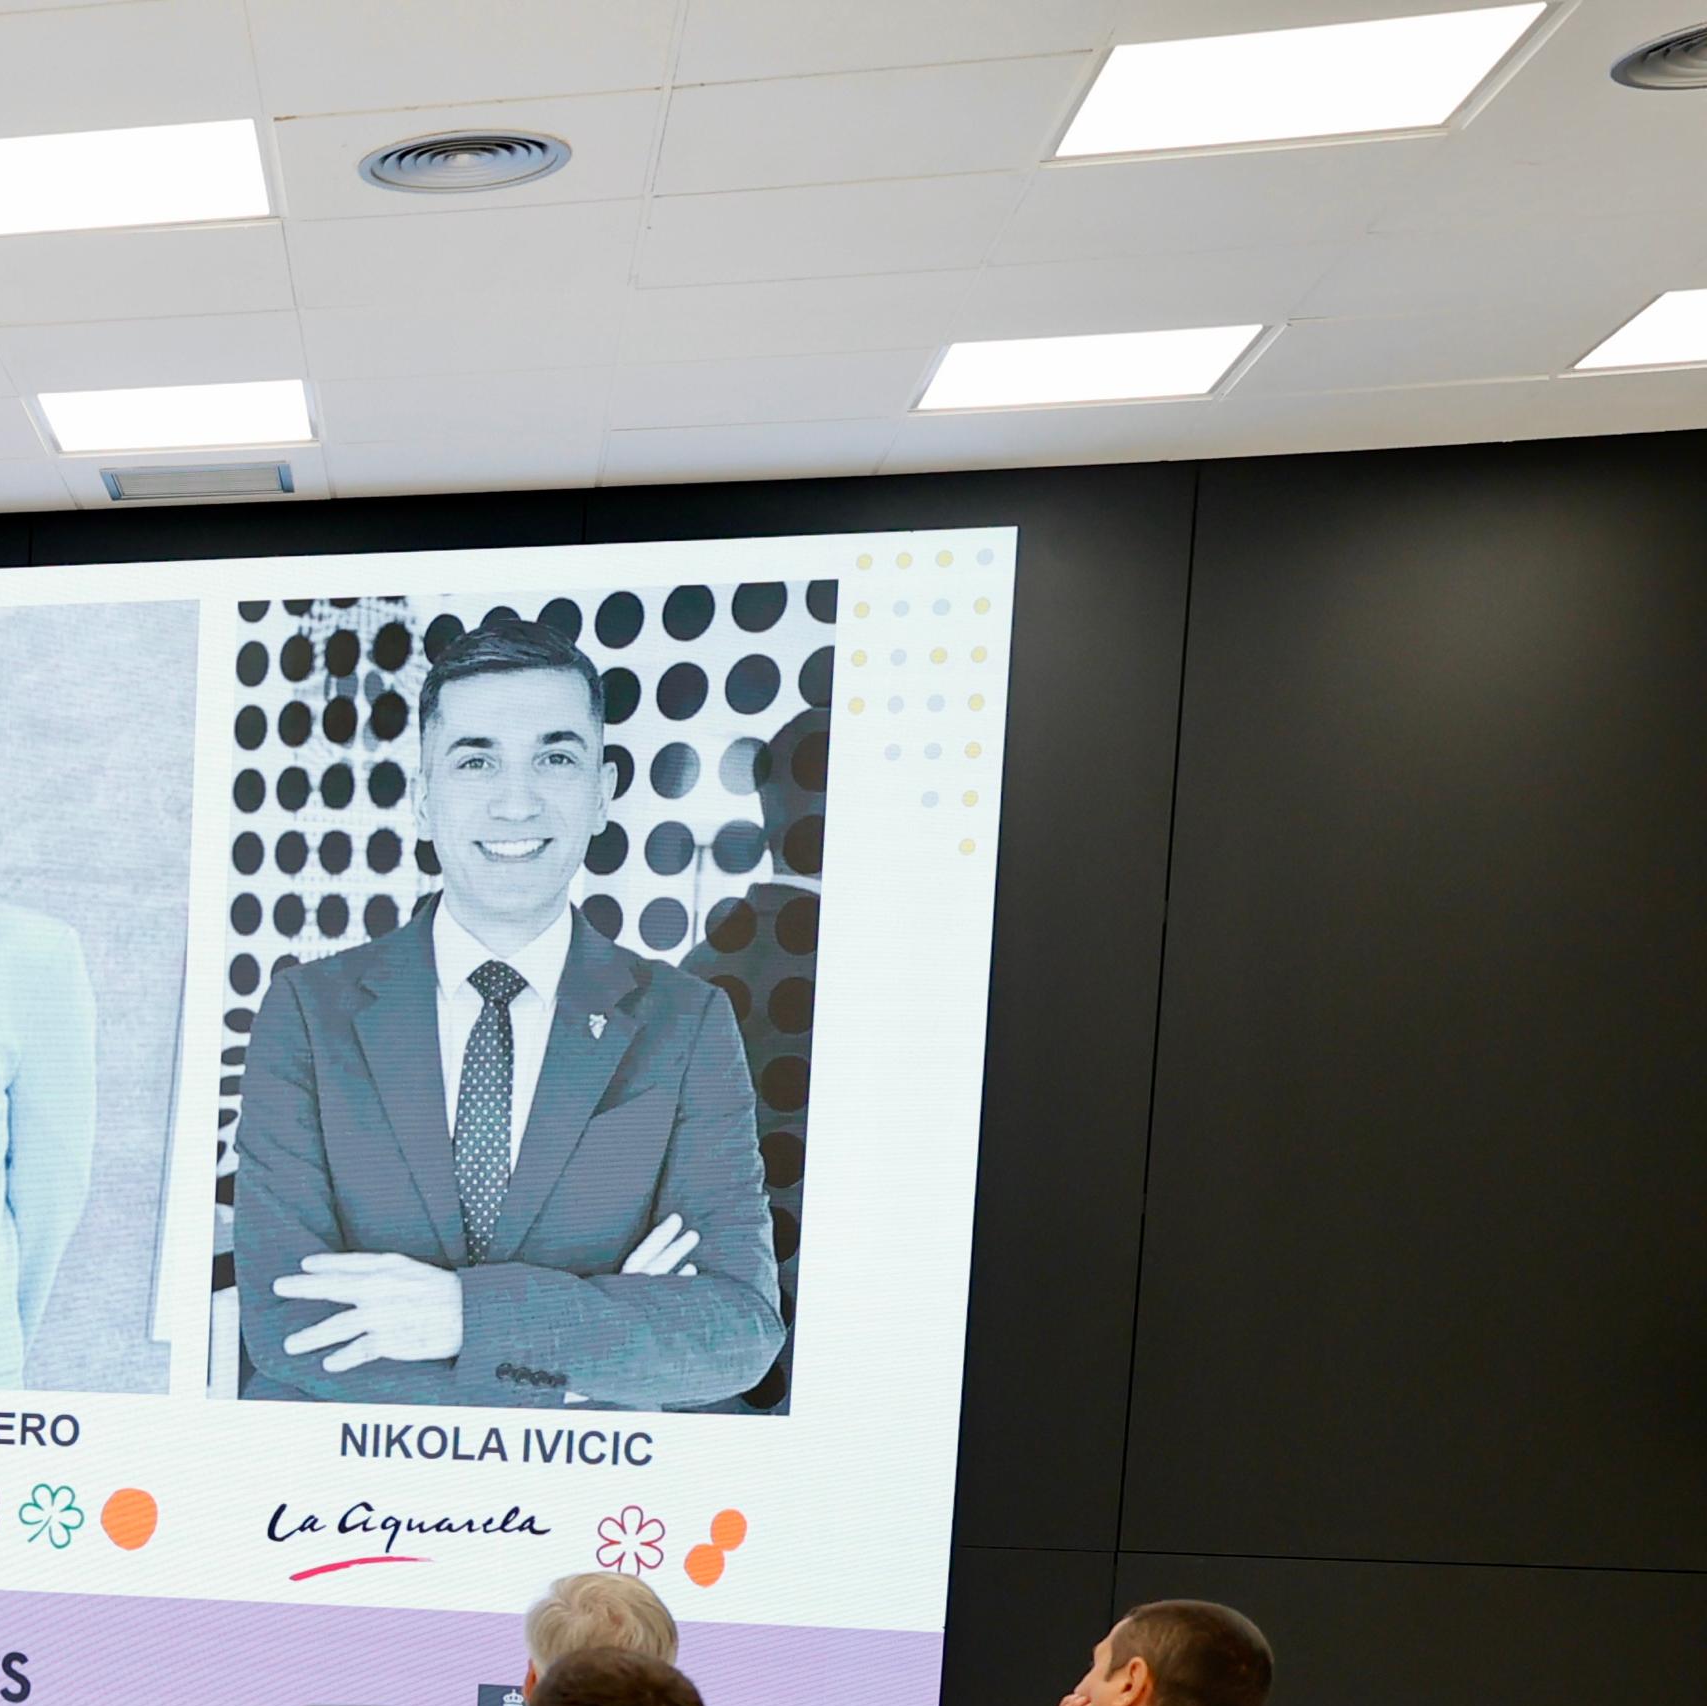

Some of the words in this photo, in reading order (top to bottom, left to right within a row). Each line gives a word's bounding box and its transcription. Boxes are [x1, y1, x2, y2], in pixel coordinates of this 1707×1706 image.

[340, 1422, 508, 1463] NIKOLA
[522, 1428, 654, 1467] IVICIC
[266, 1502, 327, 1542] La
